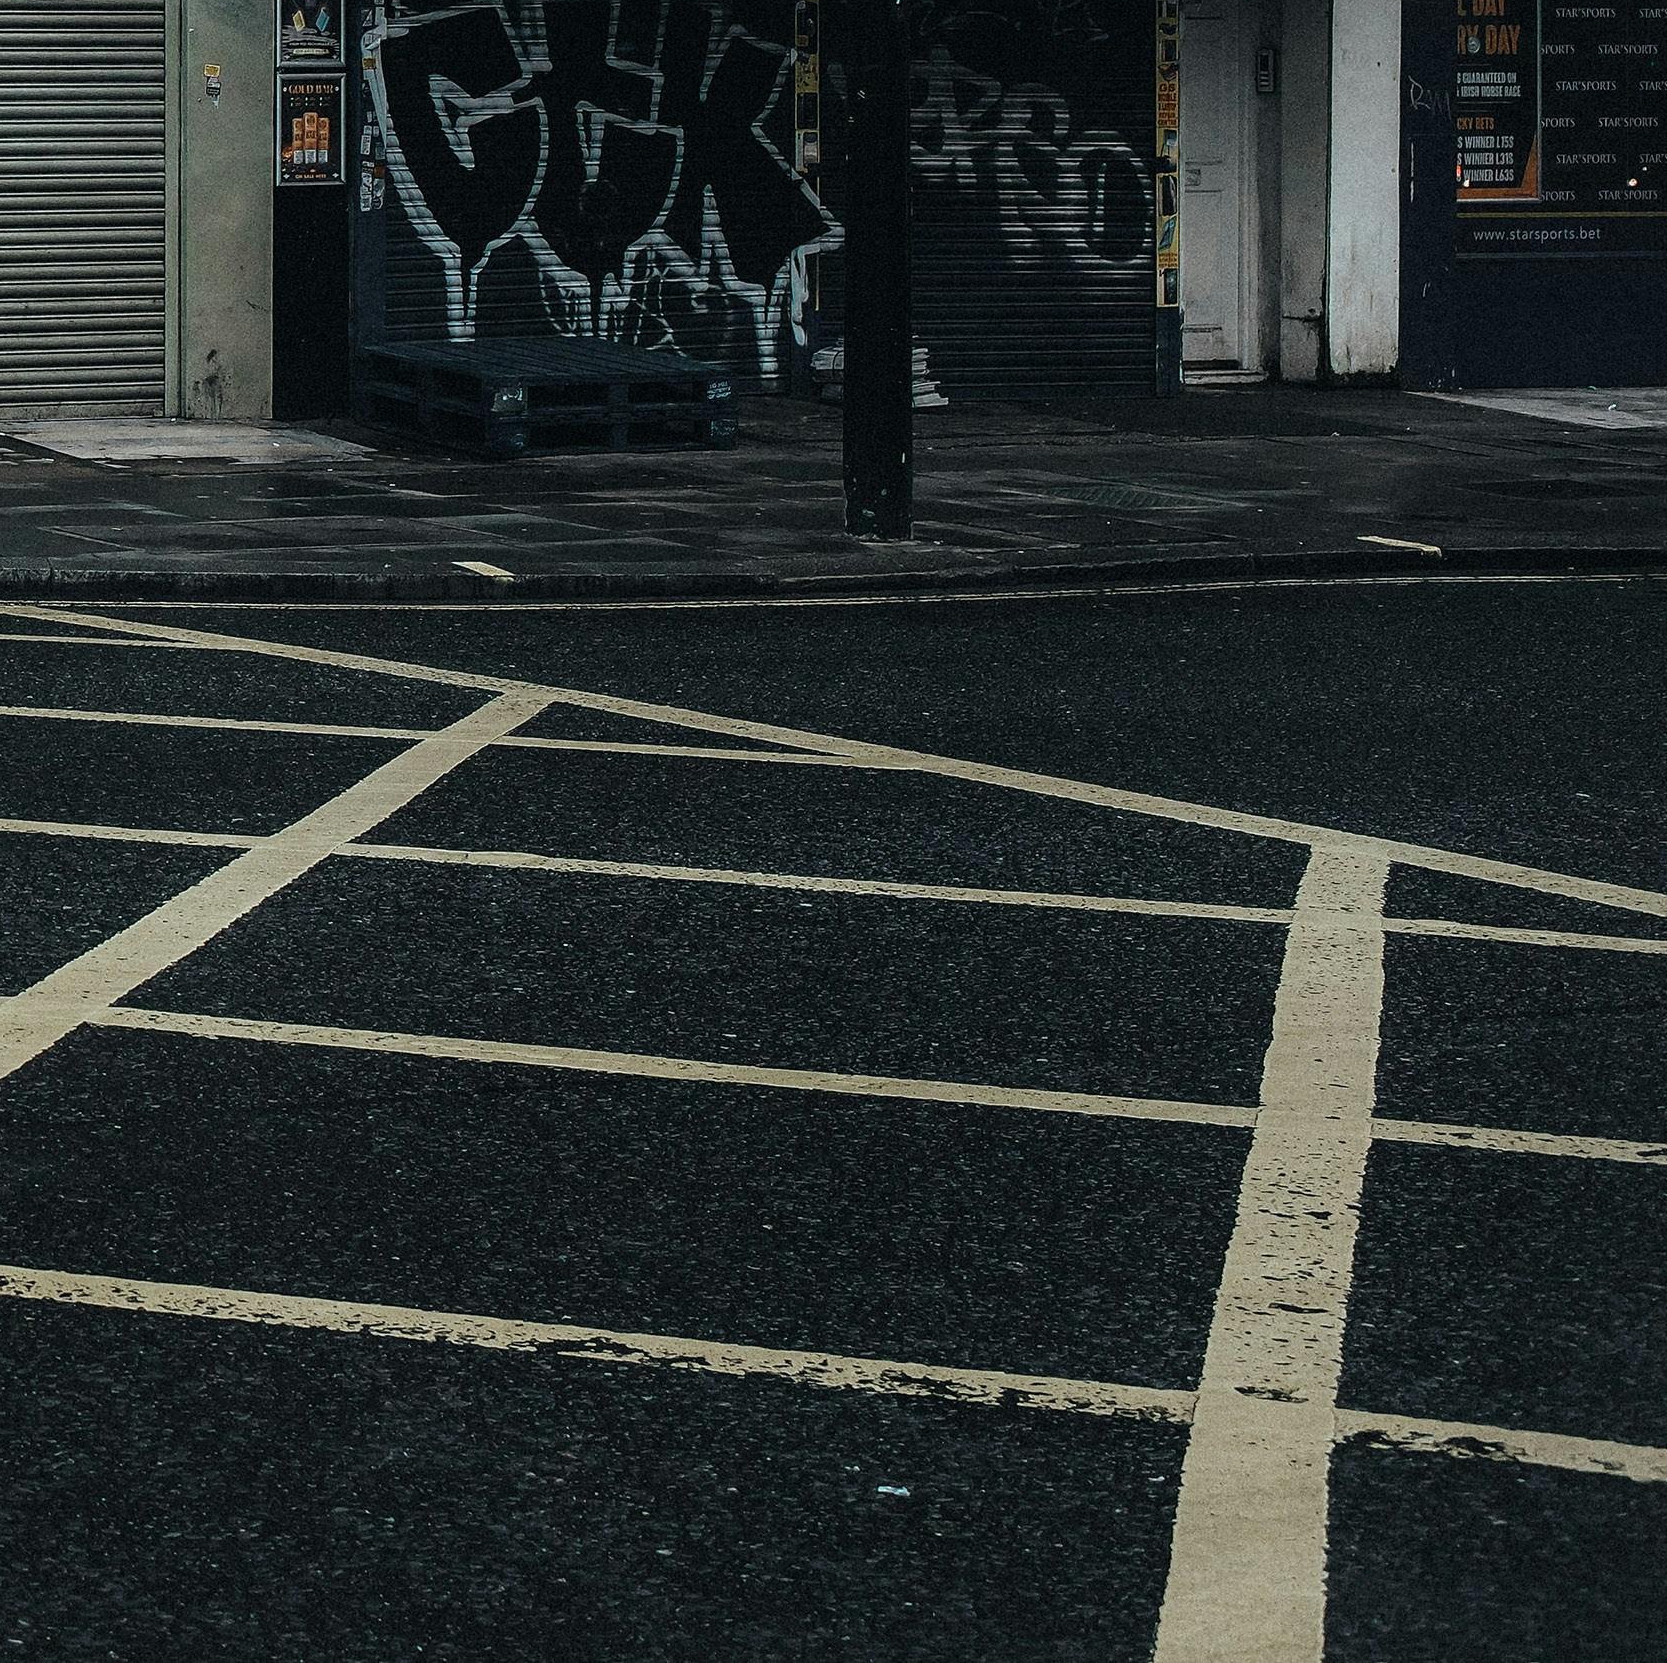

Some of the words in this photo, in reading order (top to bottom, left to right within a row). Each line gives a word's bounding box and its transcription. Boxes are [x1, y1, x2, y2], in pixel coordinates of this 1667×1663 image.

[1485, 24, 1521, 54] DAY
[1463, 72, 1506, 84] GUARANTEED
[1465, 136, 1495, 148] WINNER
[1496, 135, 1514, 148] L15S
[1464, 153, 1494, 165] WINNER
[1495, 153, 1514, 165] L31S
[1463, 169, 1493, 182] WINNER
[1495, 169, 1514, 181] L63S
[1473, 226, 1601, 244] www.starsports.bet
